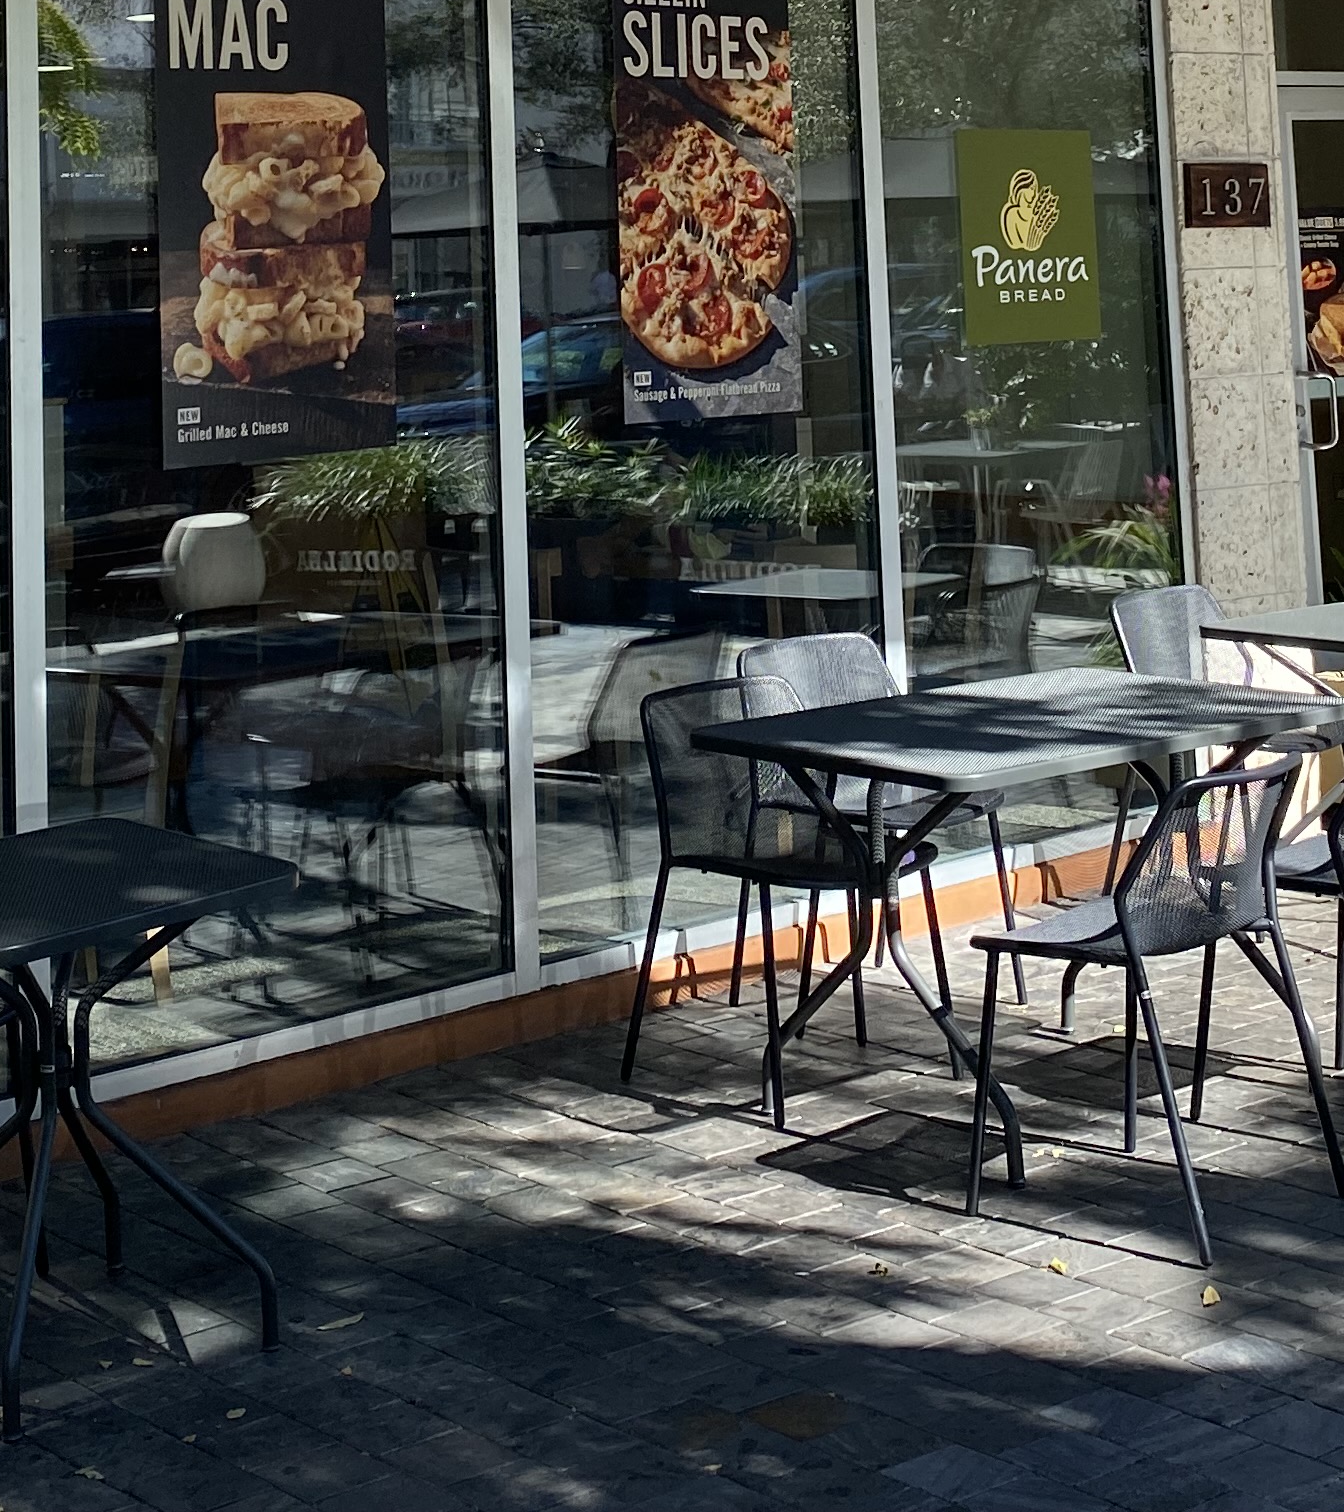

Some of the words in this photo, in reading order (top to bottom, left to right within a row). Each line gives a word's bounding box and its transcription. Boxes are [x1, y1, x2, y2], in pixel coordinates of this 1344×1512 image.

[622, 10, 771, 81] SLICES
[1201, 177, 1265, 216] 137
[971, 245, 1089, 288] Panera
[999, 288, 1066, 304] BREAD
[634, 388, 668, 403] Sausage
[670, 387, 677, 401] &
[678, 384, 720, 402] Pepperoni
[759, 380, 781, 393] Pizza
[179, 409, 200, 423] NEW
[177, 426, 212, 443] Grilled
[216, 424, 237, 440] Mac
[240, 422, 249, 437] &
[251, 421, 289, 436] Cheese
